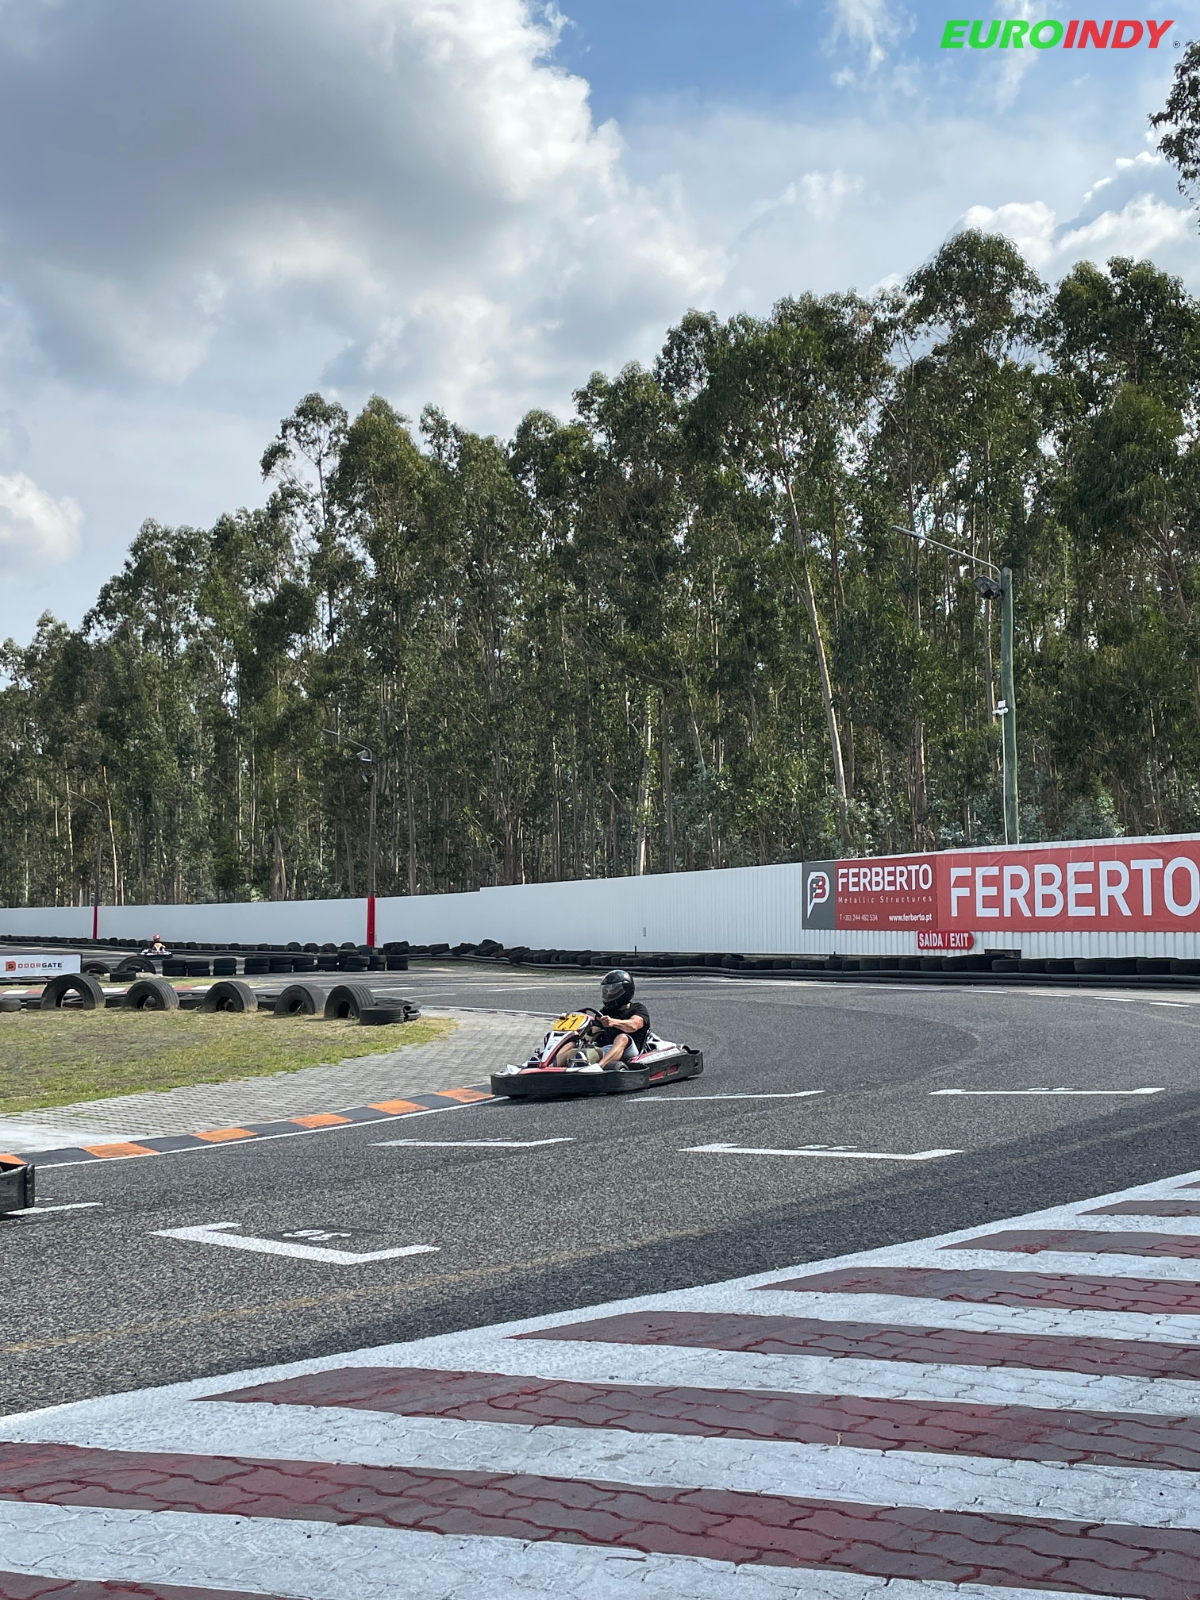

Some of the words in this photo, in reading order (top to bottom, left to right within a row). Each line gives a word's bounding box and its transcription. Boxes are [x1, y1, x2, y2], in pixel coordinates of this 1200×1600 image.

[838, 863, 933, 892] FERBERTO
[950, 856, 1200, 917] FERBERTO
[838, 896, 875, 904] Metallic
[880, 895, 932, 903] Structures
[888, 913, 933, 922] www.ferberto.pt
[949, 932, 969, 947] EXIT
